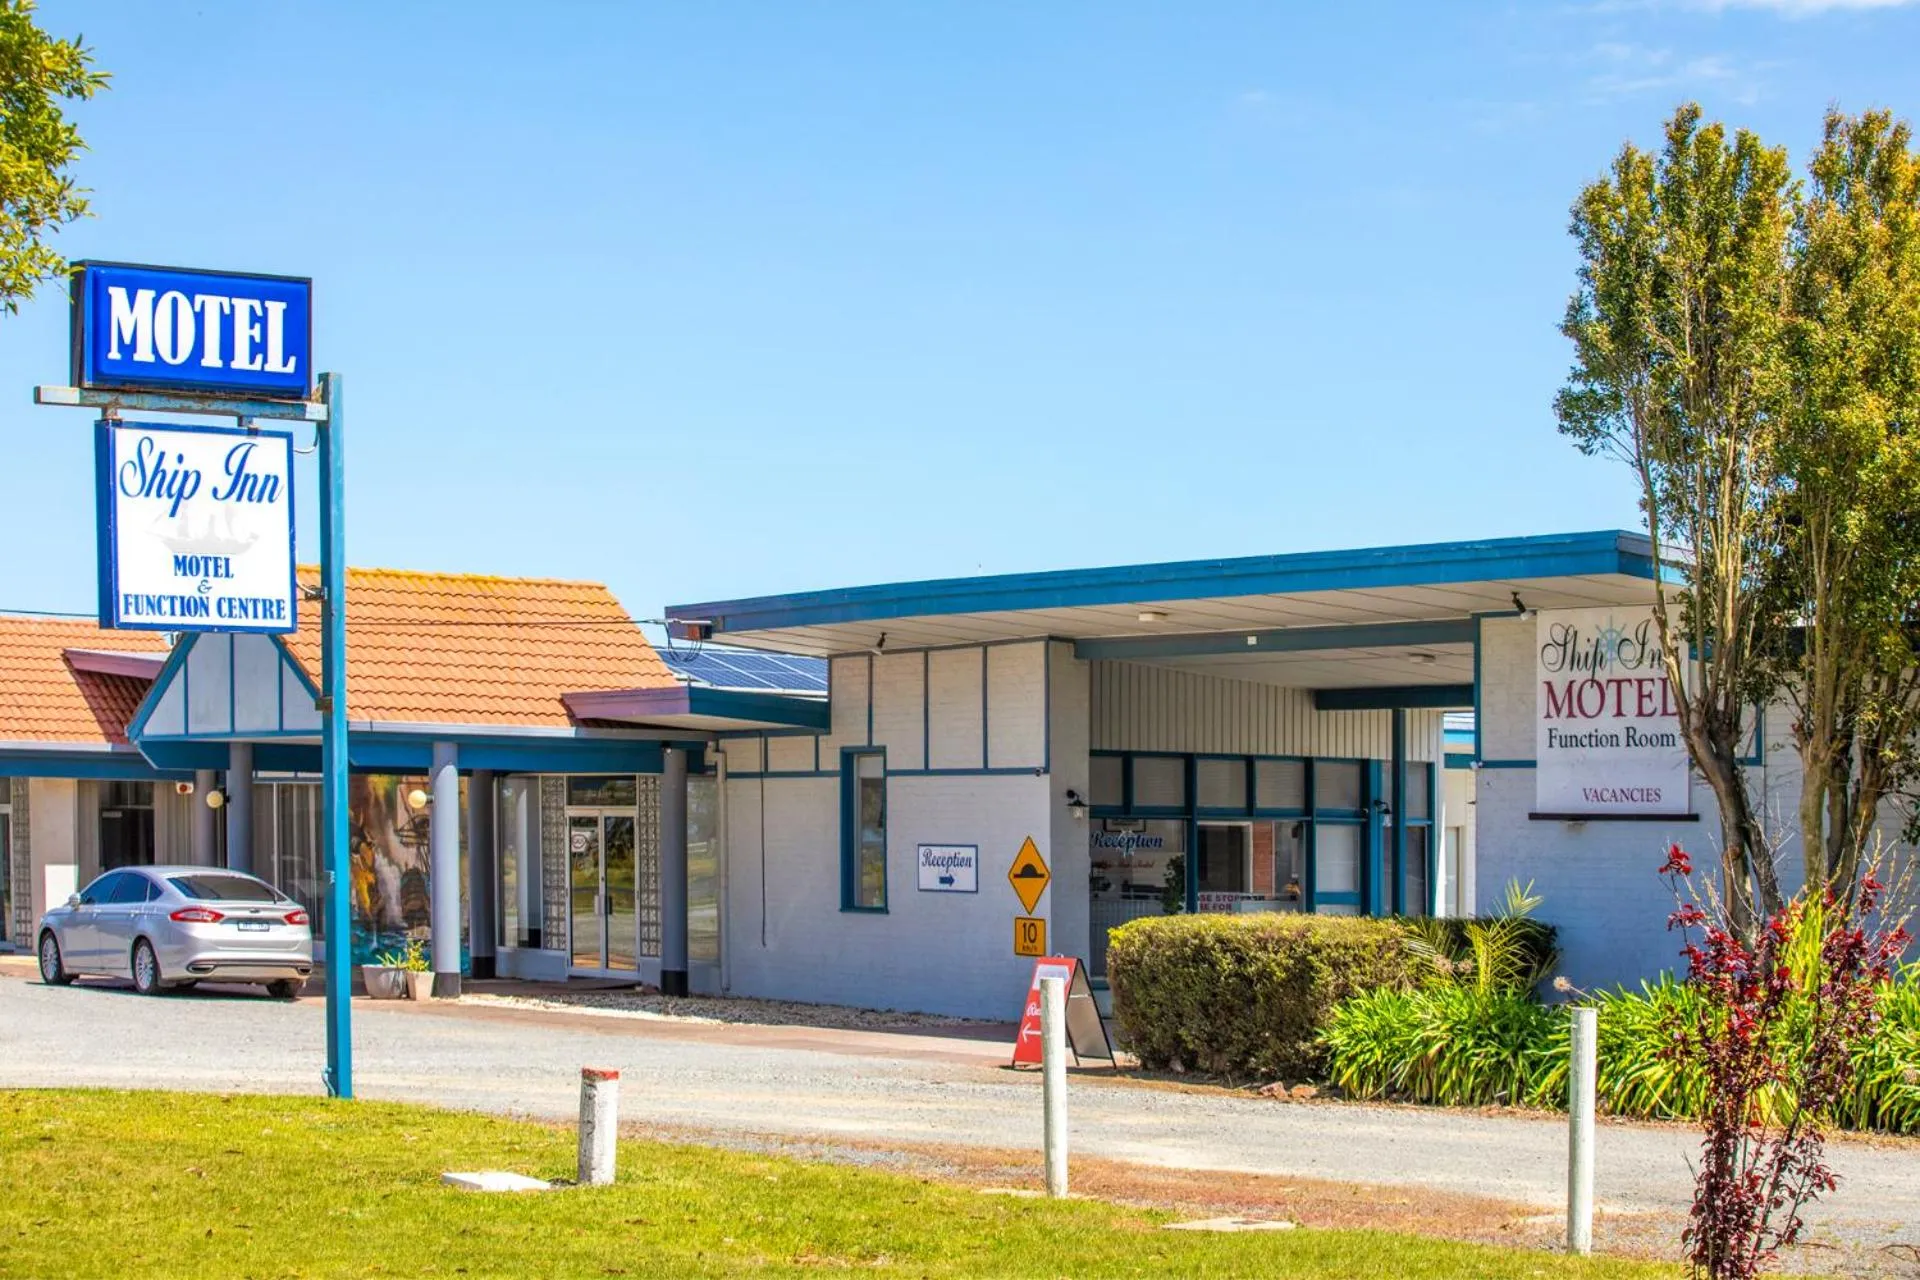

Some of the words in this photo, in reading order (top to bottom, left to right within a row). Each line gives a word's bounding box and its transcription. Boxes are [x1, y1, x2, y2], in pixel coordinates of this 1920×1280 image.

[107, 286, 297, 374] MOTEL
[119, 437, 201, 518] Ship
[212, 442, 284, 504] Inn
[173, 554, 235, 579] MOTEL
[197, 579, 213, 594] &
[123, 593, 210, 618] FUNCTION
[216, 596, 286, 620] CENTRE
[1541, 622, 1607, 689] Ship
[1618, 618, 1664, 670] In
[1543, 676, 1680, 719] MOTEL
[1547, 727, 1620, 749] Function
[1625, 726, 1676, 748] Room
[1583, 787, 1662, 803] VACANCIES
[1091, 831, 1164, 856] Reception
[921, 848, 972, 874] Reception
[1022, 922, 1038, 943] 10
